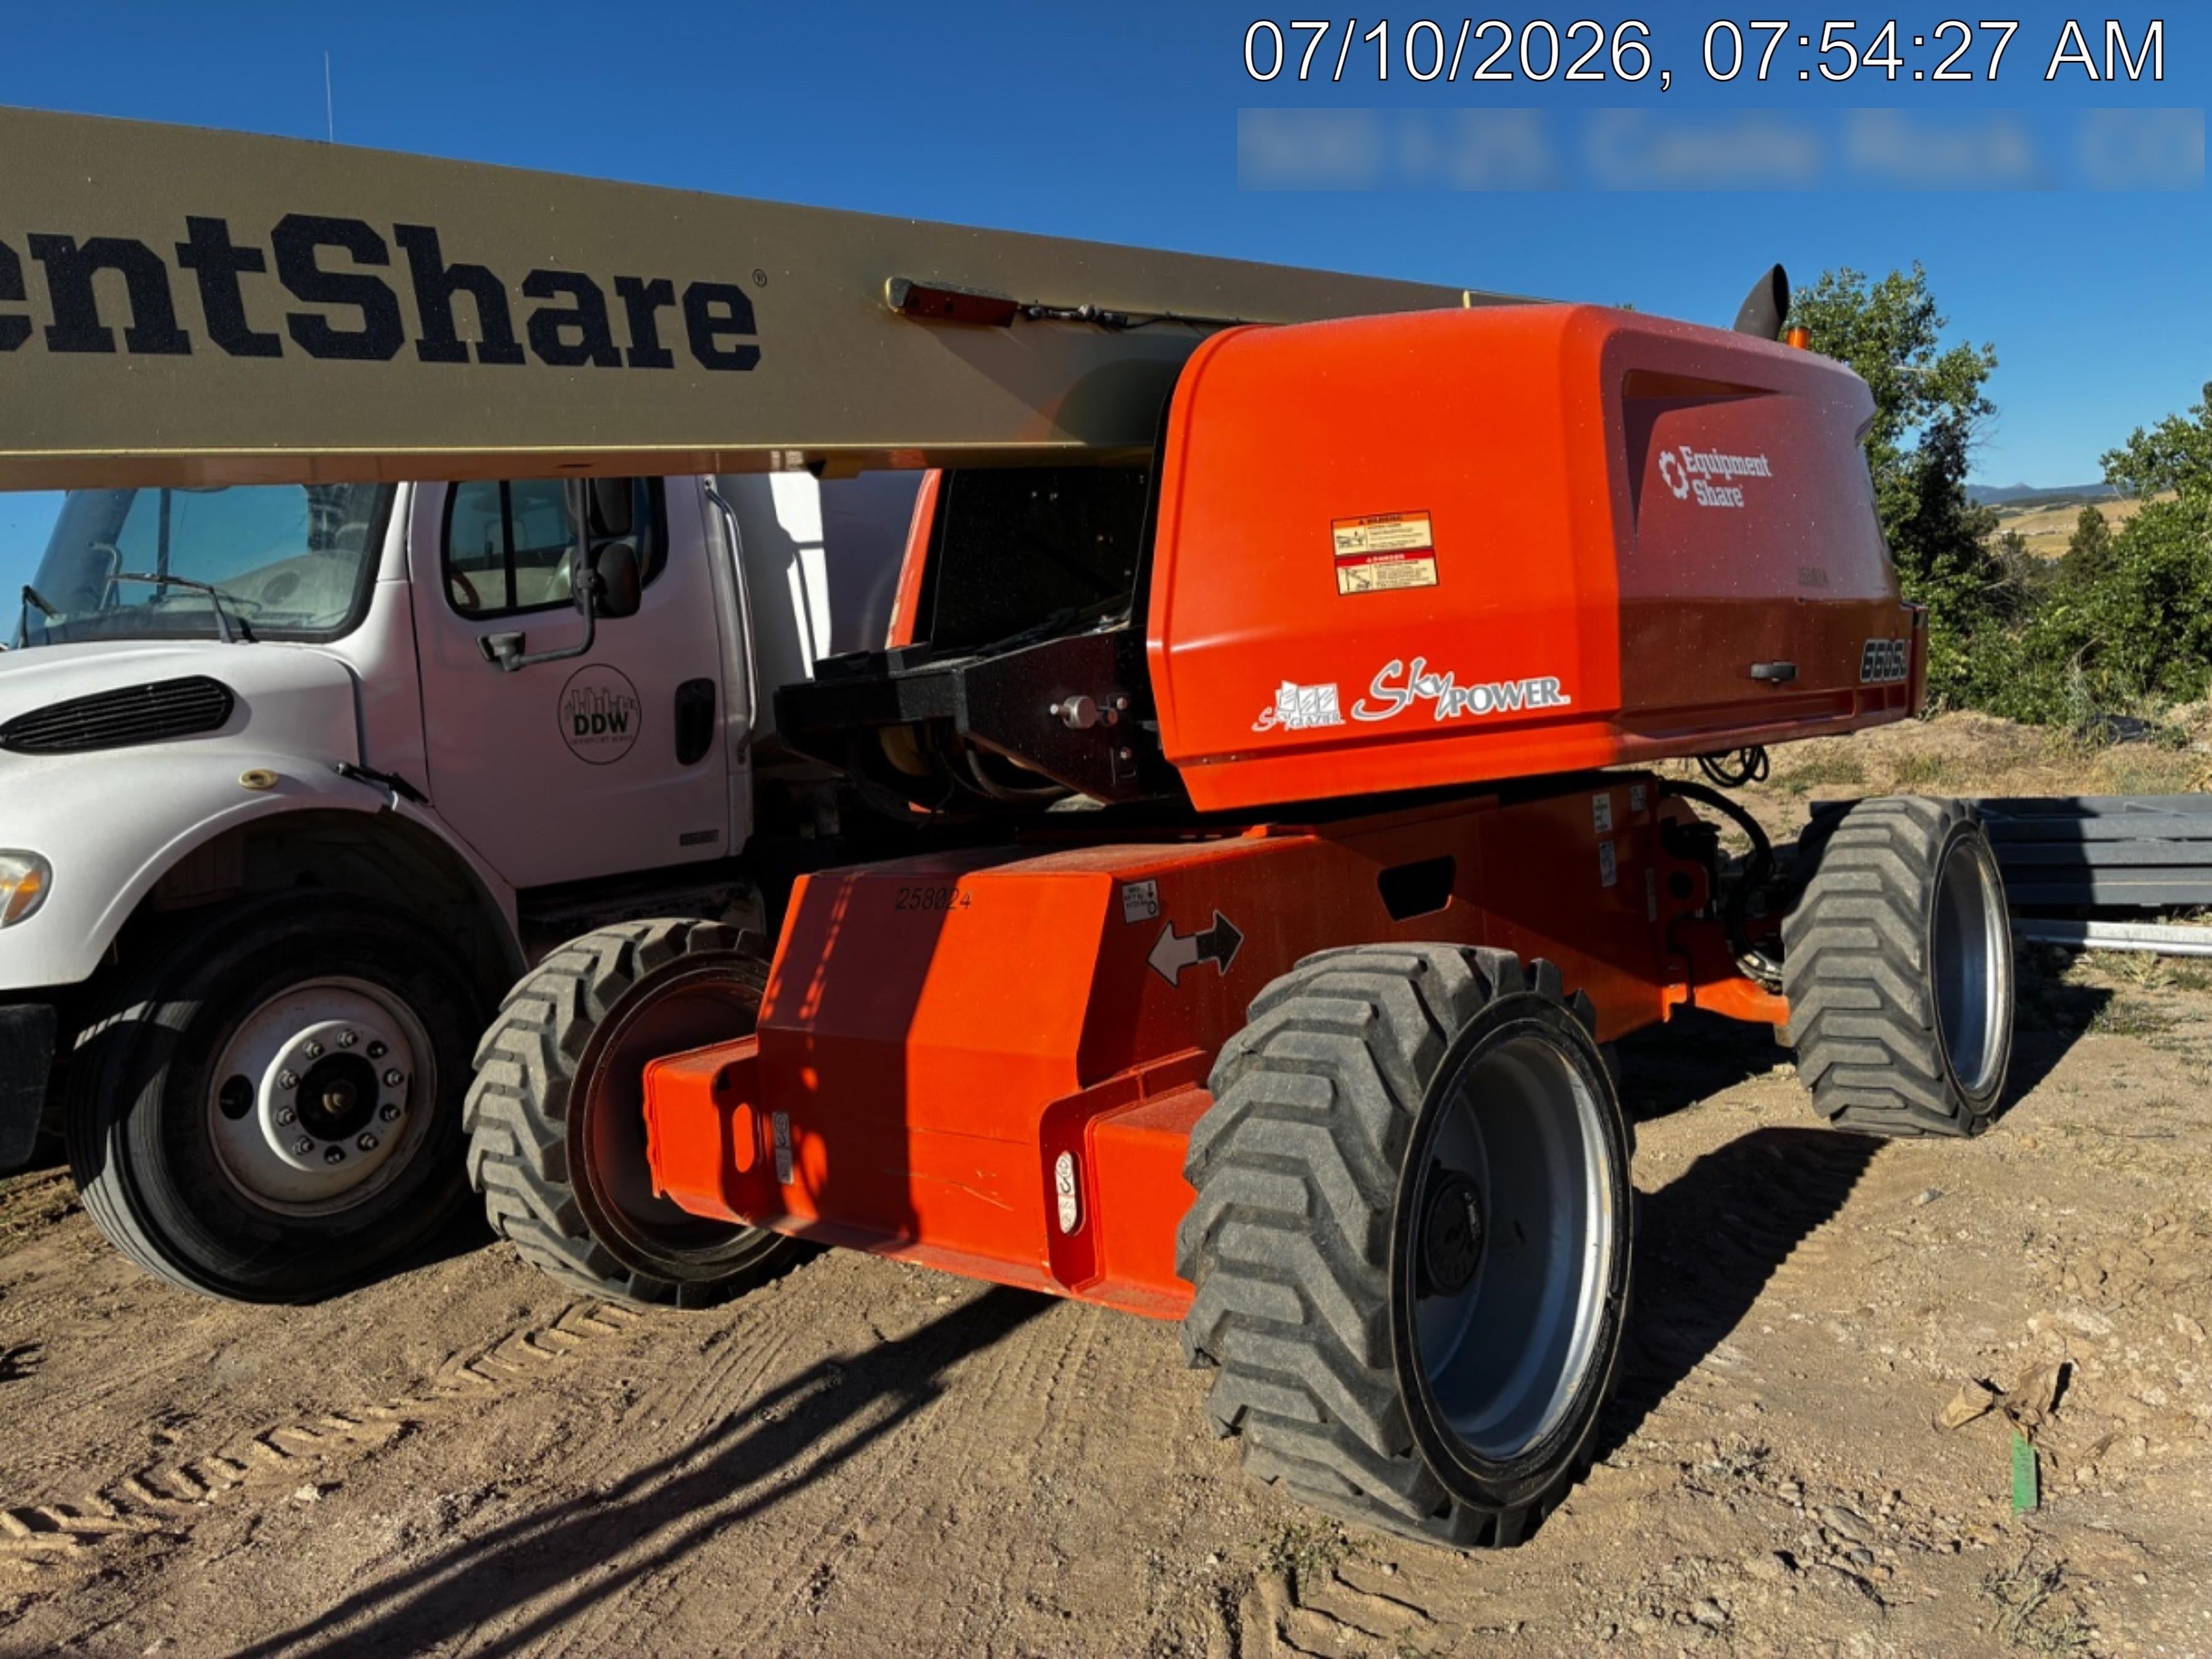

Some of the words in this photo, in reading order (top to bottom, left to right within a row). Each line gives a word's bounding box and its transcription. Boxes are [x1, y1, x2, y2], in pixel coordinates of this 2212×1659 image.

[1679, 445, 1772, 480] Equipment
[1692, 479, 1744, 508] Share
[575, 712, 628, 735] DDW
[895, 887, 973, 910] 258024
